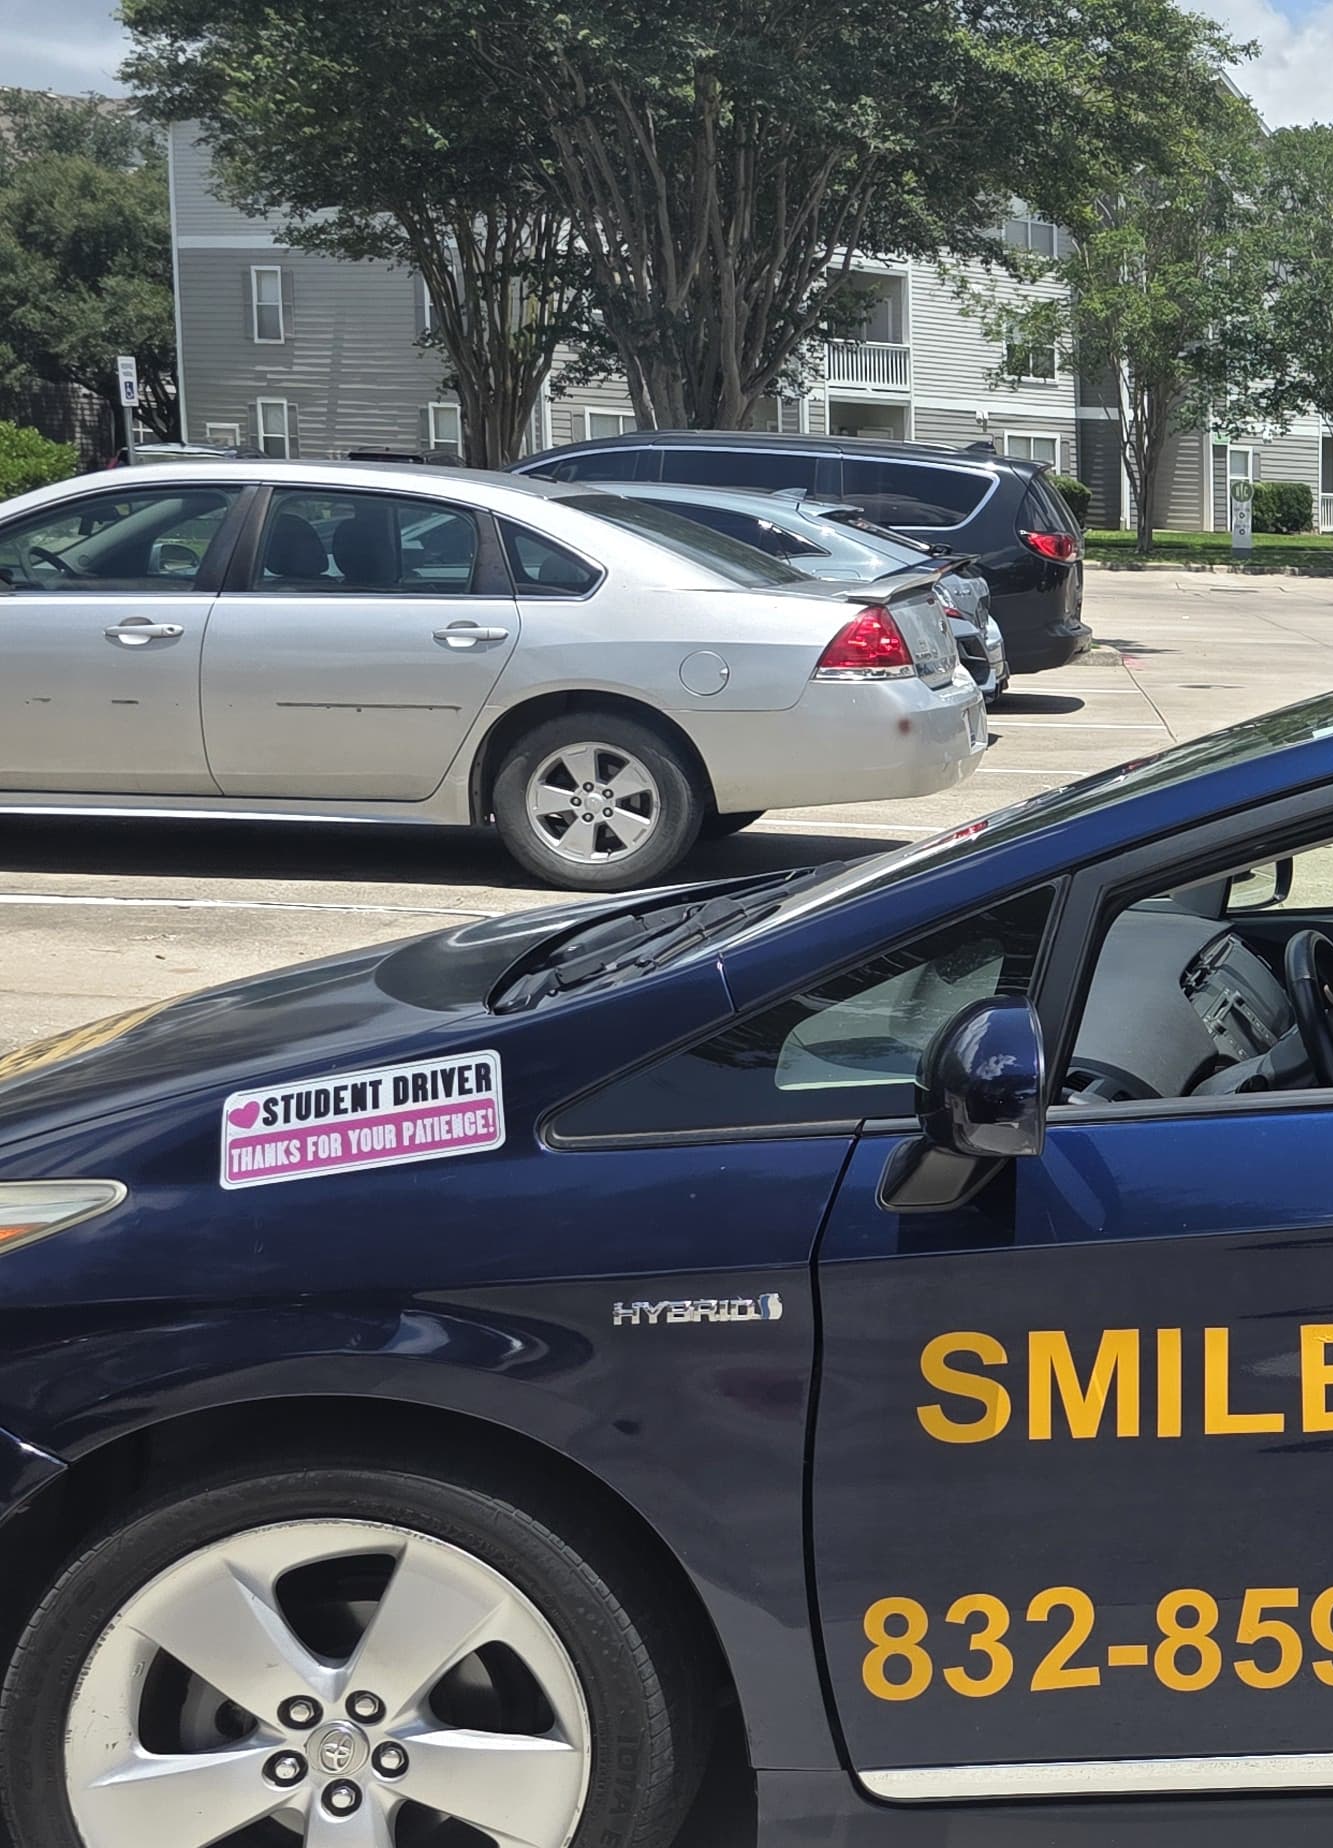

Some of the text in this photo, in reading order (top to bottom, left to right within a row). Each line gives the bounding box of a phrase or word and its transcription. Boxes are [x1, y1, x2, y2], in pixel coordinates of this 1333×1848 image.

[261, 1062, 493, 1127] STUDENT DRIVER
[231, 1108, 496, 1174] THANKS FOR YOUR PATIENCE!
[612, 1297, 757, 1327] HYBRID
